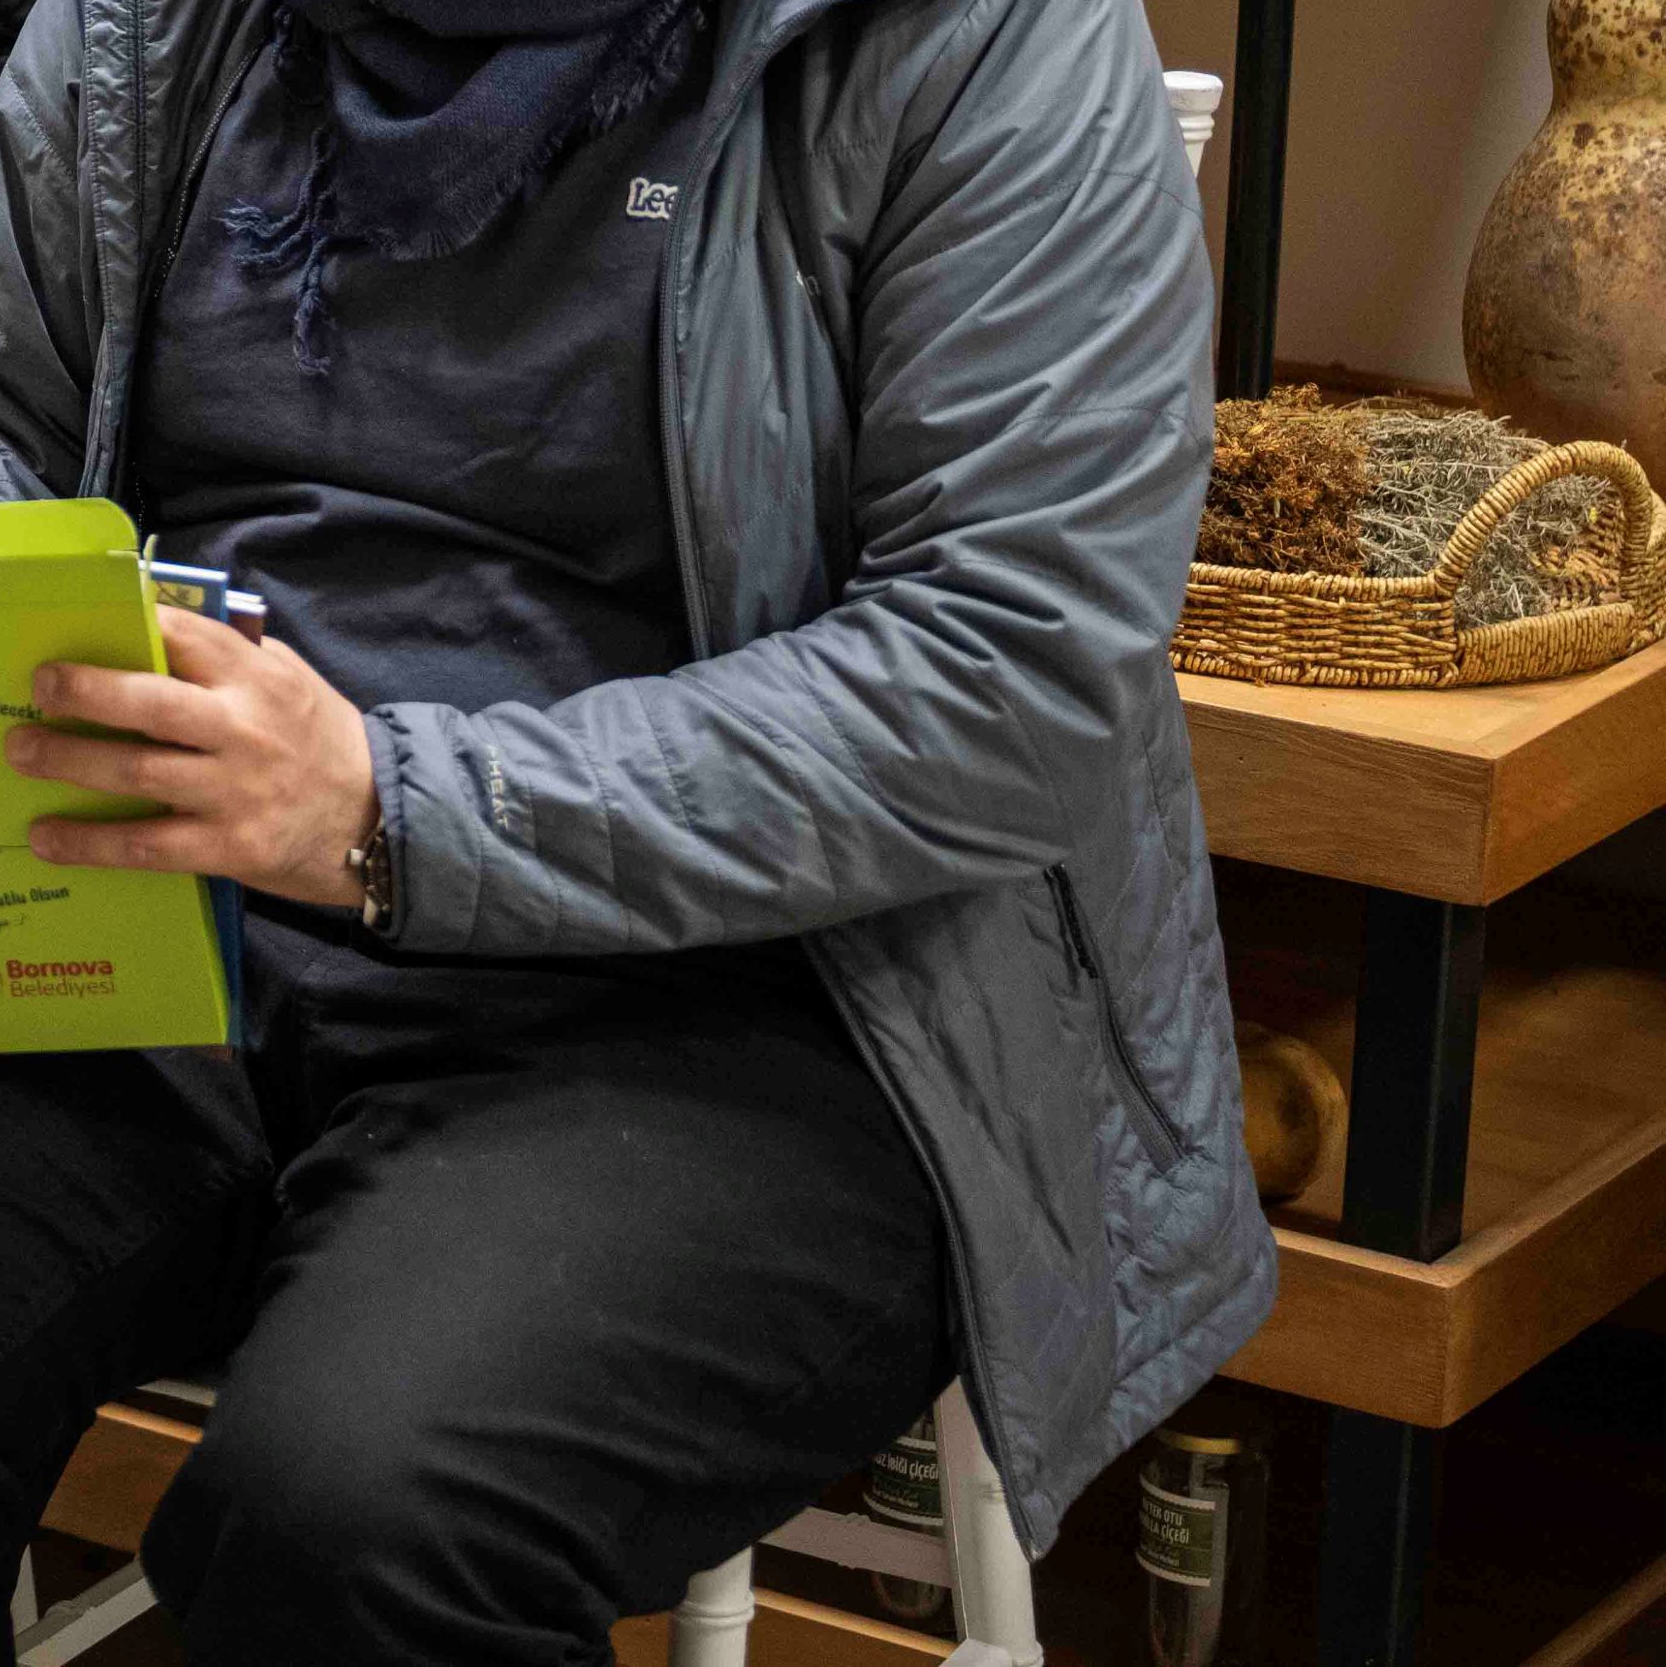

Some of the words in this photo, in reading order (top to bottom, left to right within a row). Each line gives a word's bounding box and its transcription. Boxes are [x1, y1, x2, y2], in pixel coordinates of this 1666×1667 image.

[29, 885, 71, 903] Olsun
[5, 958, 116, 981] Bornova
[9, 978, 118, 1001] Belediyesi
[909, 1460, 939, 1482] ÇİÇEĞİ
[1163, 1508, 1184, 1527] OTU
